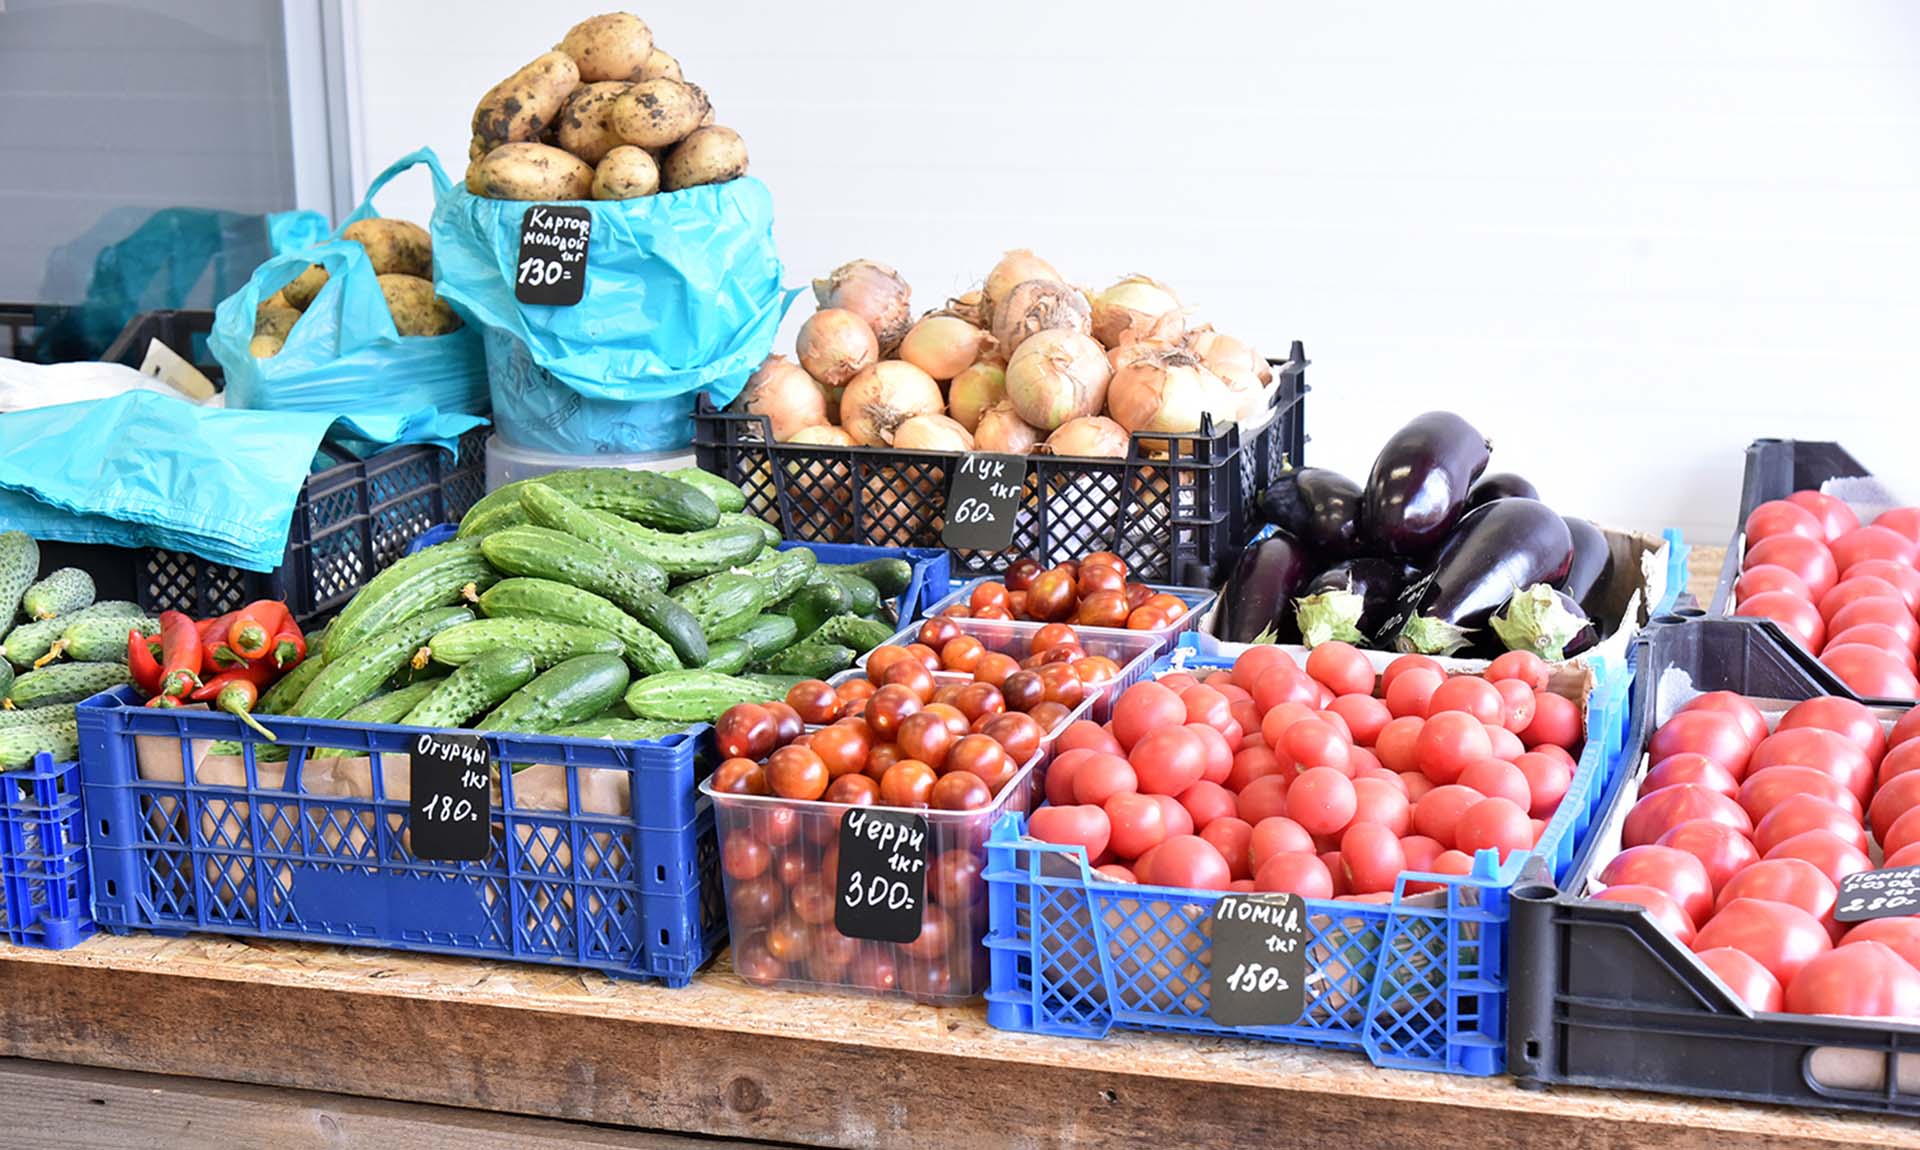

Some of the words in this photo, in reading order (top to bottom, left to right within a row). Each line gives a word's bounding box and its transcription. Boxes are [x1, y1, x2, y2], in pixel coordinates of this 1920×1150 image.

[960, 454, 1005, 480] Лук
[989, 482, 1021, 499] 1кг
[418, 734, 486, 766] Огурцы
[461, 769, 488, 789] 1кг
[848, 811, 924, 852] Черри
[888, 853, 923, 872] 1кг
[1217, 898, 1302, 933] Помид.
[1265, 935, 1297, 953] 1кг
